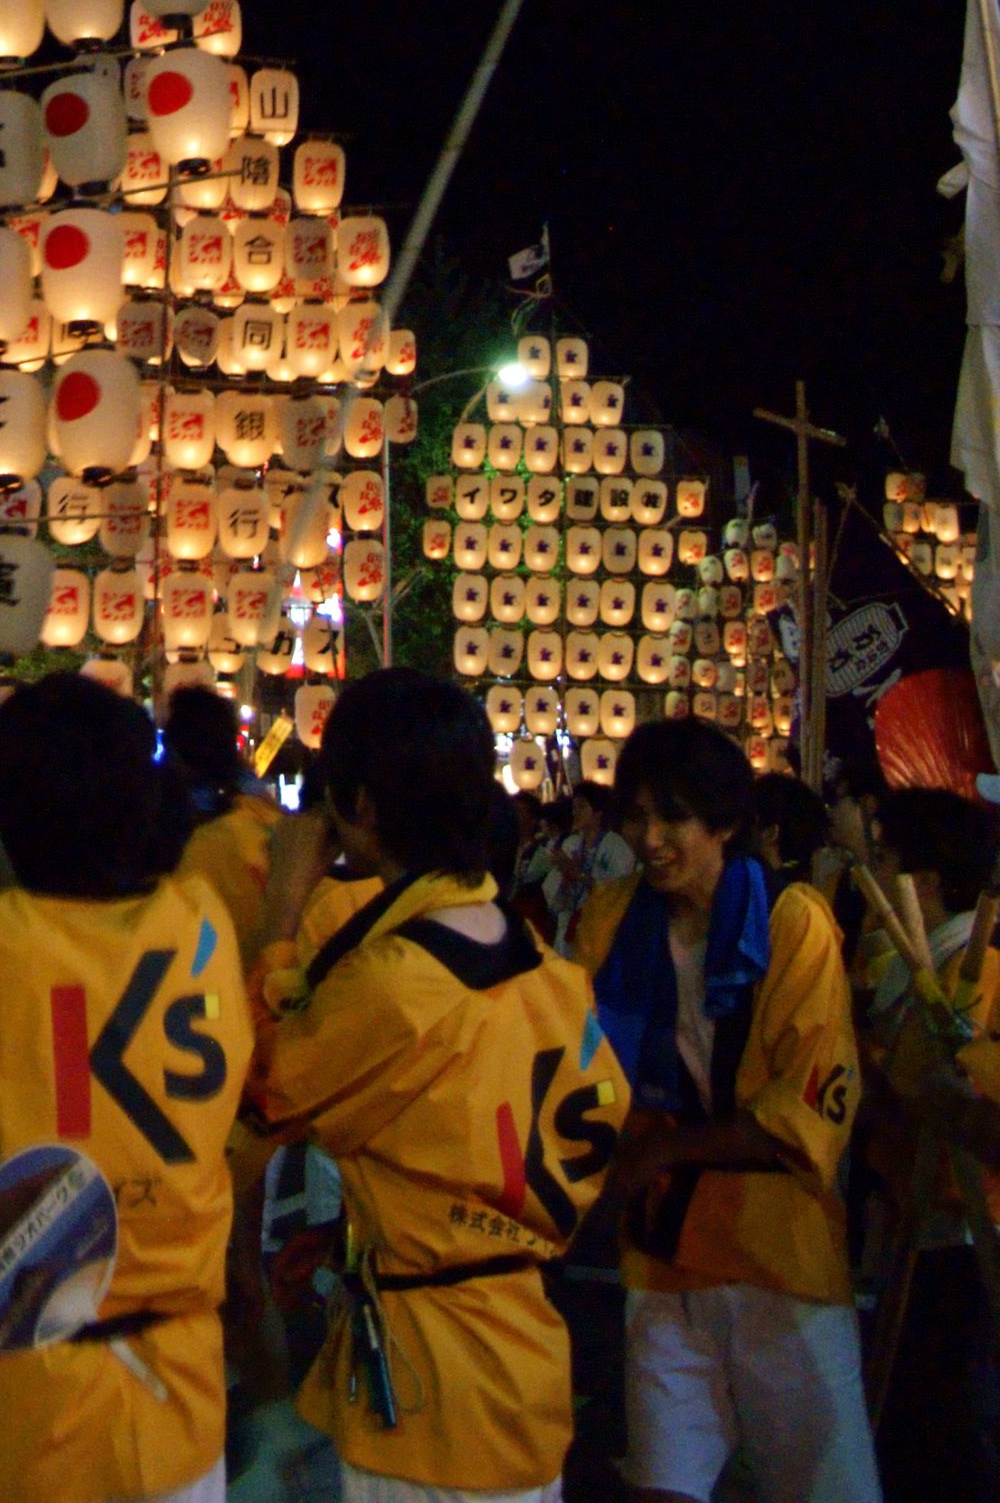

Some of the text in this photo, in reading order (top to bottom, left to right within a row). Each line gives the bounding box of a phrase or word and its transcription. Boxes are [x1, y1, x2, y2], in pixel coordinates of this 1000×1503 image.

[260, 87, 289, 120] 山
[244, 234, 275, 265] 合
[57, 492, 91, 525] 行
[228, 506, 261, 539] 行
